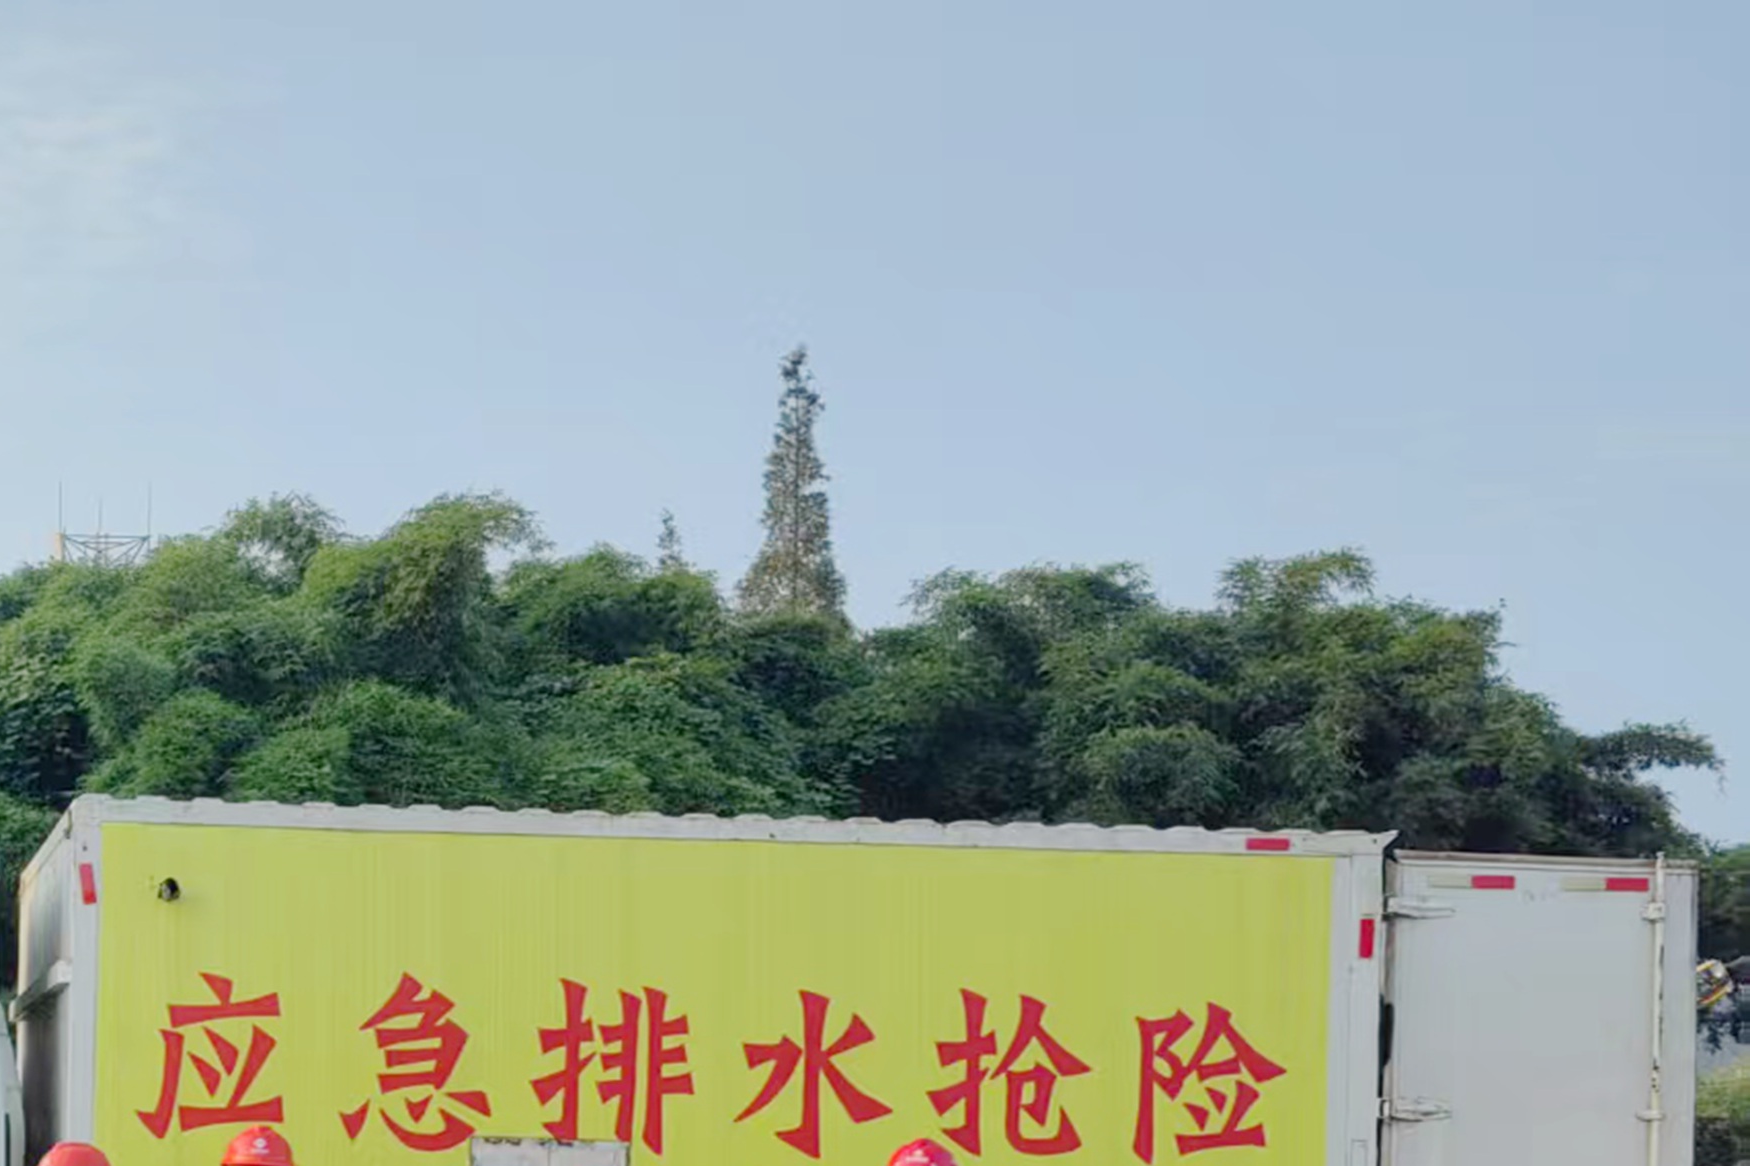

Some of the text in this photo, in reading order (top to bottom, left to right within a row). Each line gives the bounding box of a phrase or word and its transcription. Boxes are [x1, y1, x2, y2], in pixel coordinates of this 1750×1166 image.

[136, 971, 1286, 1165] 应急排水抢险
